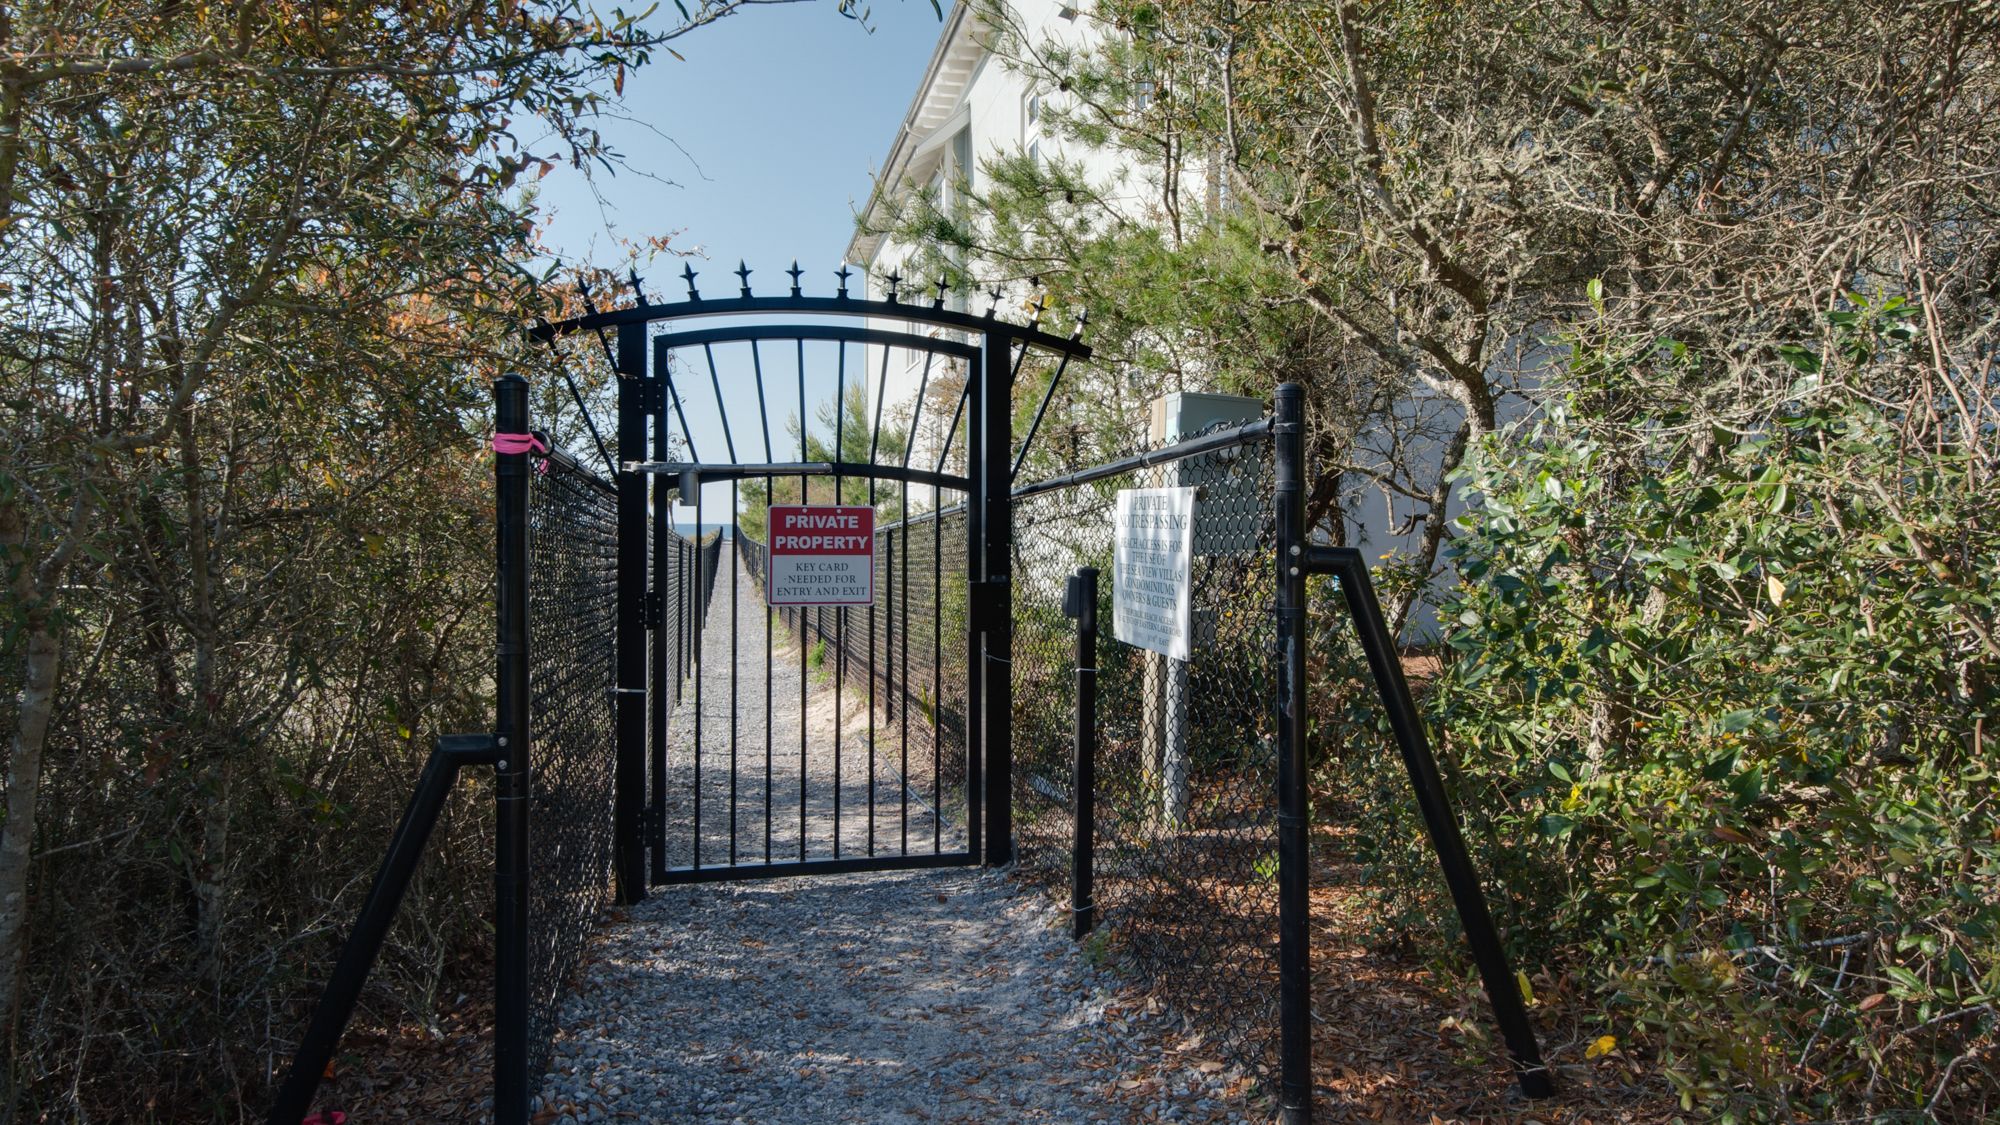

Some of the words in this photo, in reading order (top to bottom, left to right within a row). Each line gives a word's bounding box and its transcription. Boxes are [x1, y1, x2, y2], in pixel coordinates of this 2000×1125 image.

[1134, 496, 1168, 510] PRIVATE
[785, 515, 859, 528] PRIVATE
[1119, 514, 1130, 528] NO
[1130, 514, 1188, 530] TRESPASSING
[775, 536, 868, 550] PROPERTY
[1120, 536, 1138, 550] BEACH
[1140, 538, 1160, 551] ACCESS
[1162, 540, 1168, 552] IS
[1169, 540, 1183, 553] FOR
[1132, 551, 1144, 563] THE
[1156, 554, 1167, 566] OF
[796, 563, 816, 572] KEY
[818, 563, 849, 572] CARD
[788, 575, 832, 584] NEEDED
[835, 575, 856, 584] FOR
[1159, 568, 1182, 583] VILLAS
[777, 587, 812, 596] ENTRY
[816, 587, 839, 596] AND
[843, 587, 866, 596] EXIT
[1125, 578, 1175, 596] CONDOMINIUMS
[1122, 591, 1146, 606] OWNERS
[1146, 595, 1152, 606] &
[1152, 596, 1177, 611] GUESTS
